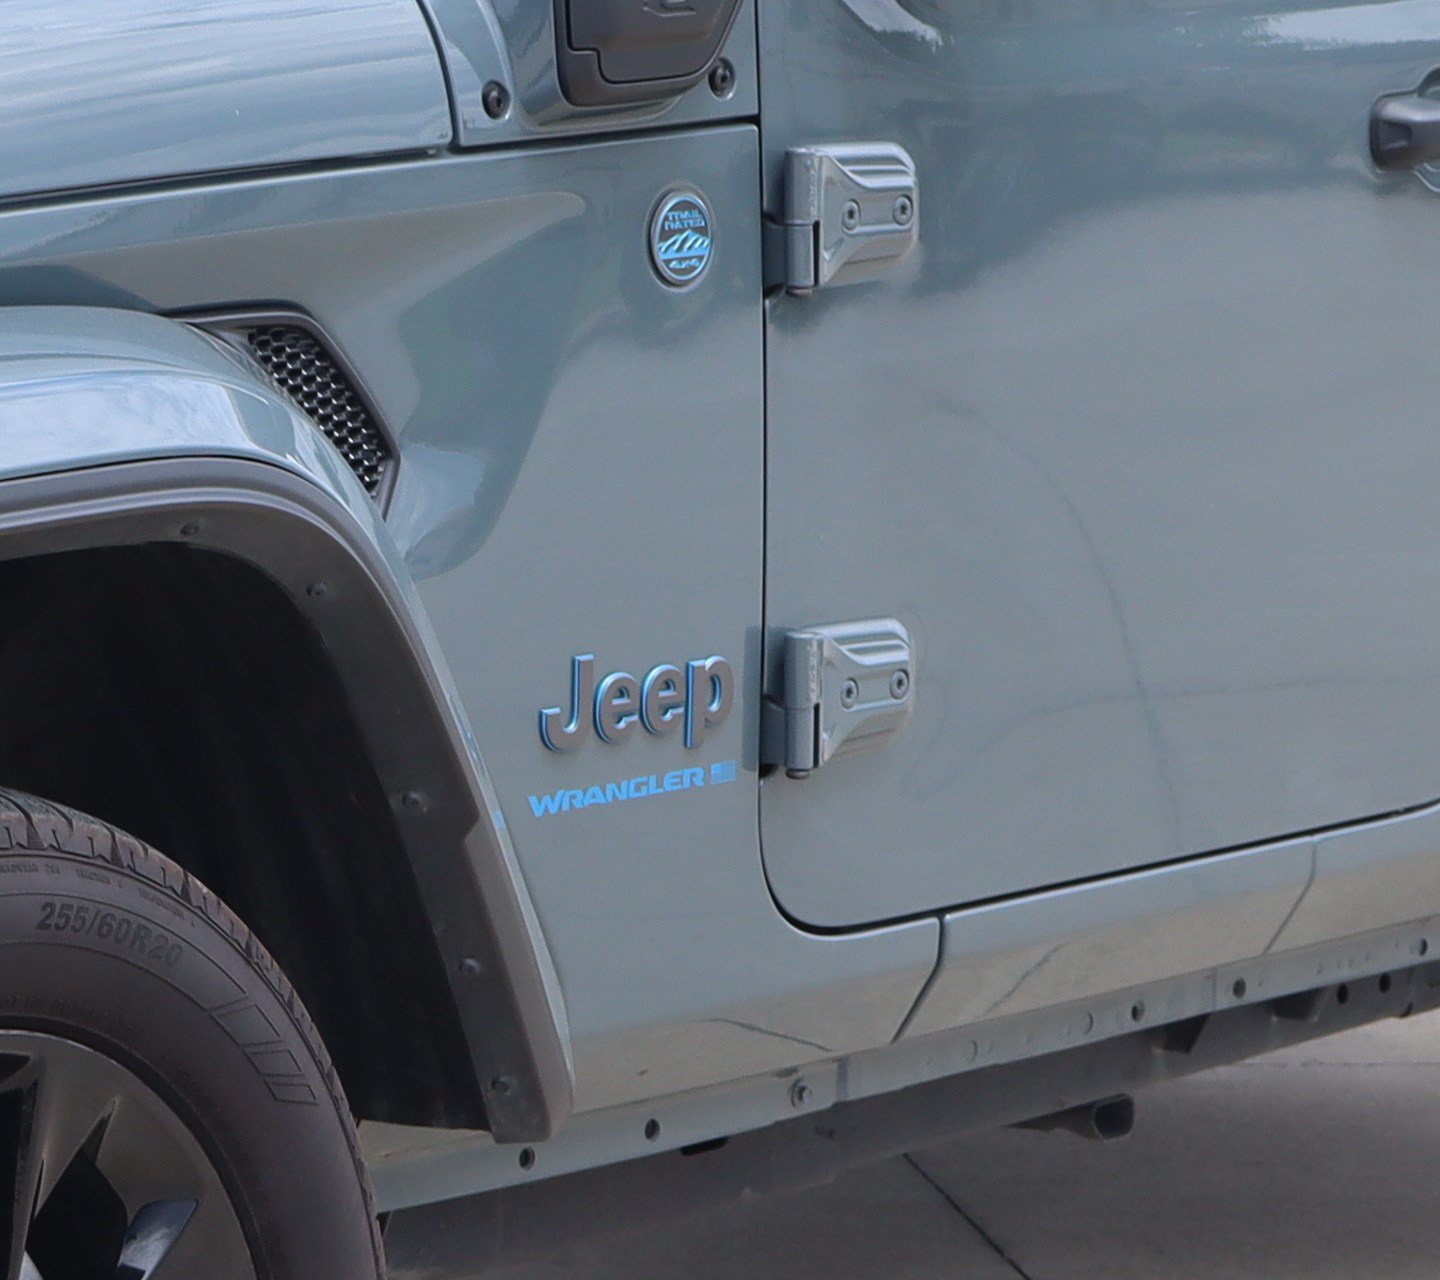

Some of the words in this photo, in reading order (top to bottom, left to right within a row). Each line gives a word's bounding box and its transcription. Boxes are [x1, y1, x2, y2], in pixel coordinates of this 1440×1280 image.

[539, 652, 734, 752] Jeep
[528, 766, 706, 818] WRANGLER
[36, 901, 184, 968] 255/60R20
